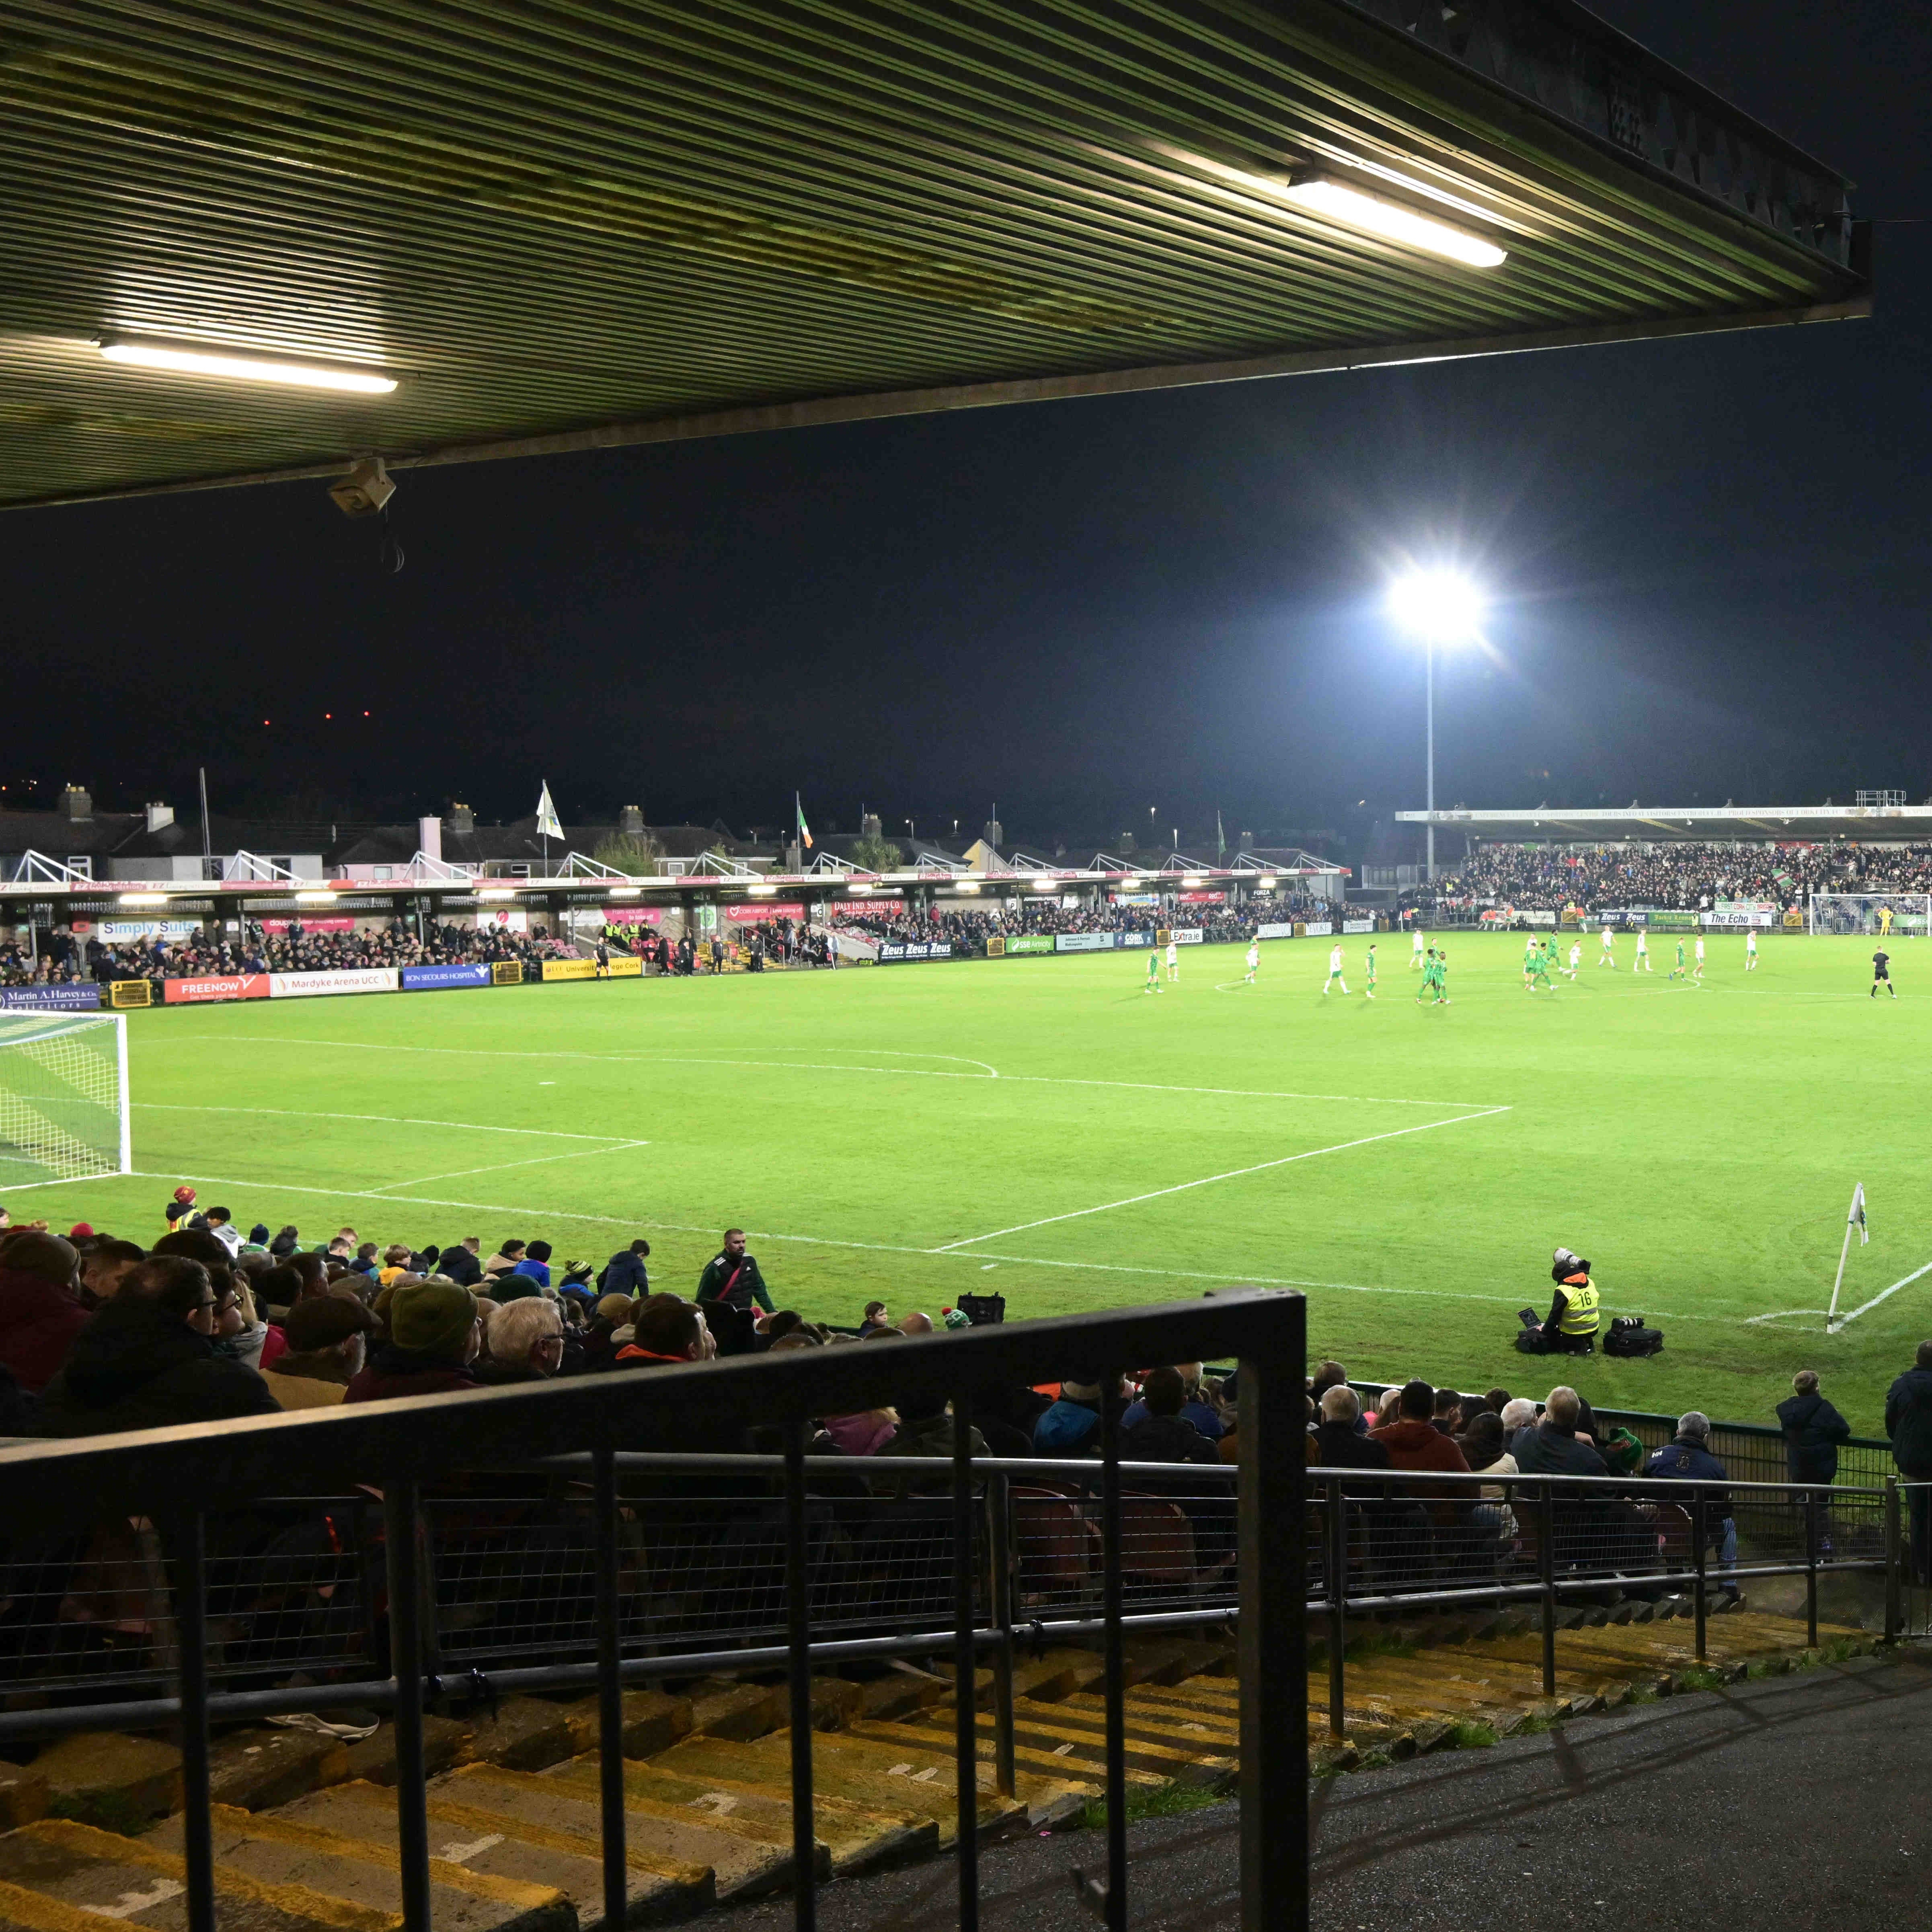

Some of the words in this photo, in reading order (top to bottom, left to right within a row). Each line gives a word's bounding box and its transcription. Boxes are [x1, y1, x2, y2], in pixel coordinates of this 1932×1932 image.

[834, 901, 852, 911] DALY
[852, 901, 866, 910] IND.
[867, 901, 889, 910] SUPPLY
[890, 900, 901, 909] CO.
[1626, 913, 1645, 921] Zeus
[1711, 914, 1726, 923] The
[1728, 914, 1748, 924] Echo
[104, 922, 154, 936] Simply
[160, 921, 195, 932] Suits
[1309, 923, 1328, 933] EVOKE
[1125, 933, 1143, 941] CORK
[1174, 931, 1200, 941] Extra.ie
[881, 944, 904, 956] Zeus
[906, 943, 928, 955] Zeus
[930, 942, 951, 953] Zeus
[1031, 940, 1051, 948] Airtricity
[292, 978, 331, 988] Mardyke
[361, 976, 379, 984] UCC
[182, 981, 239, 994] FREENOW
[8, 991, 37, 1001] Martin
[41, 990, 50, 1000] A.
[52, 990, 80, 1000] Harvey
[7, 1002, 80, 1010] Solicitors
[1579, 1291, 1592, 1307] 16
